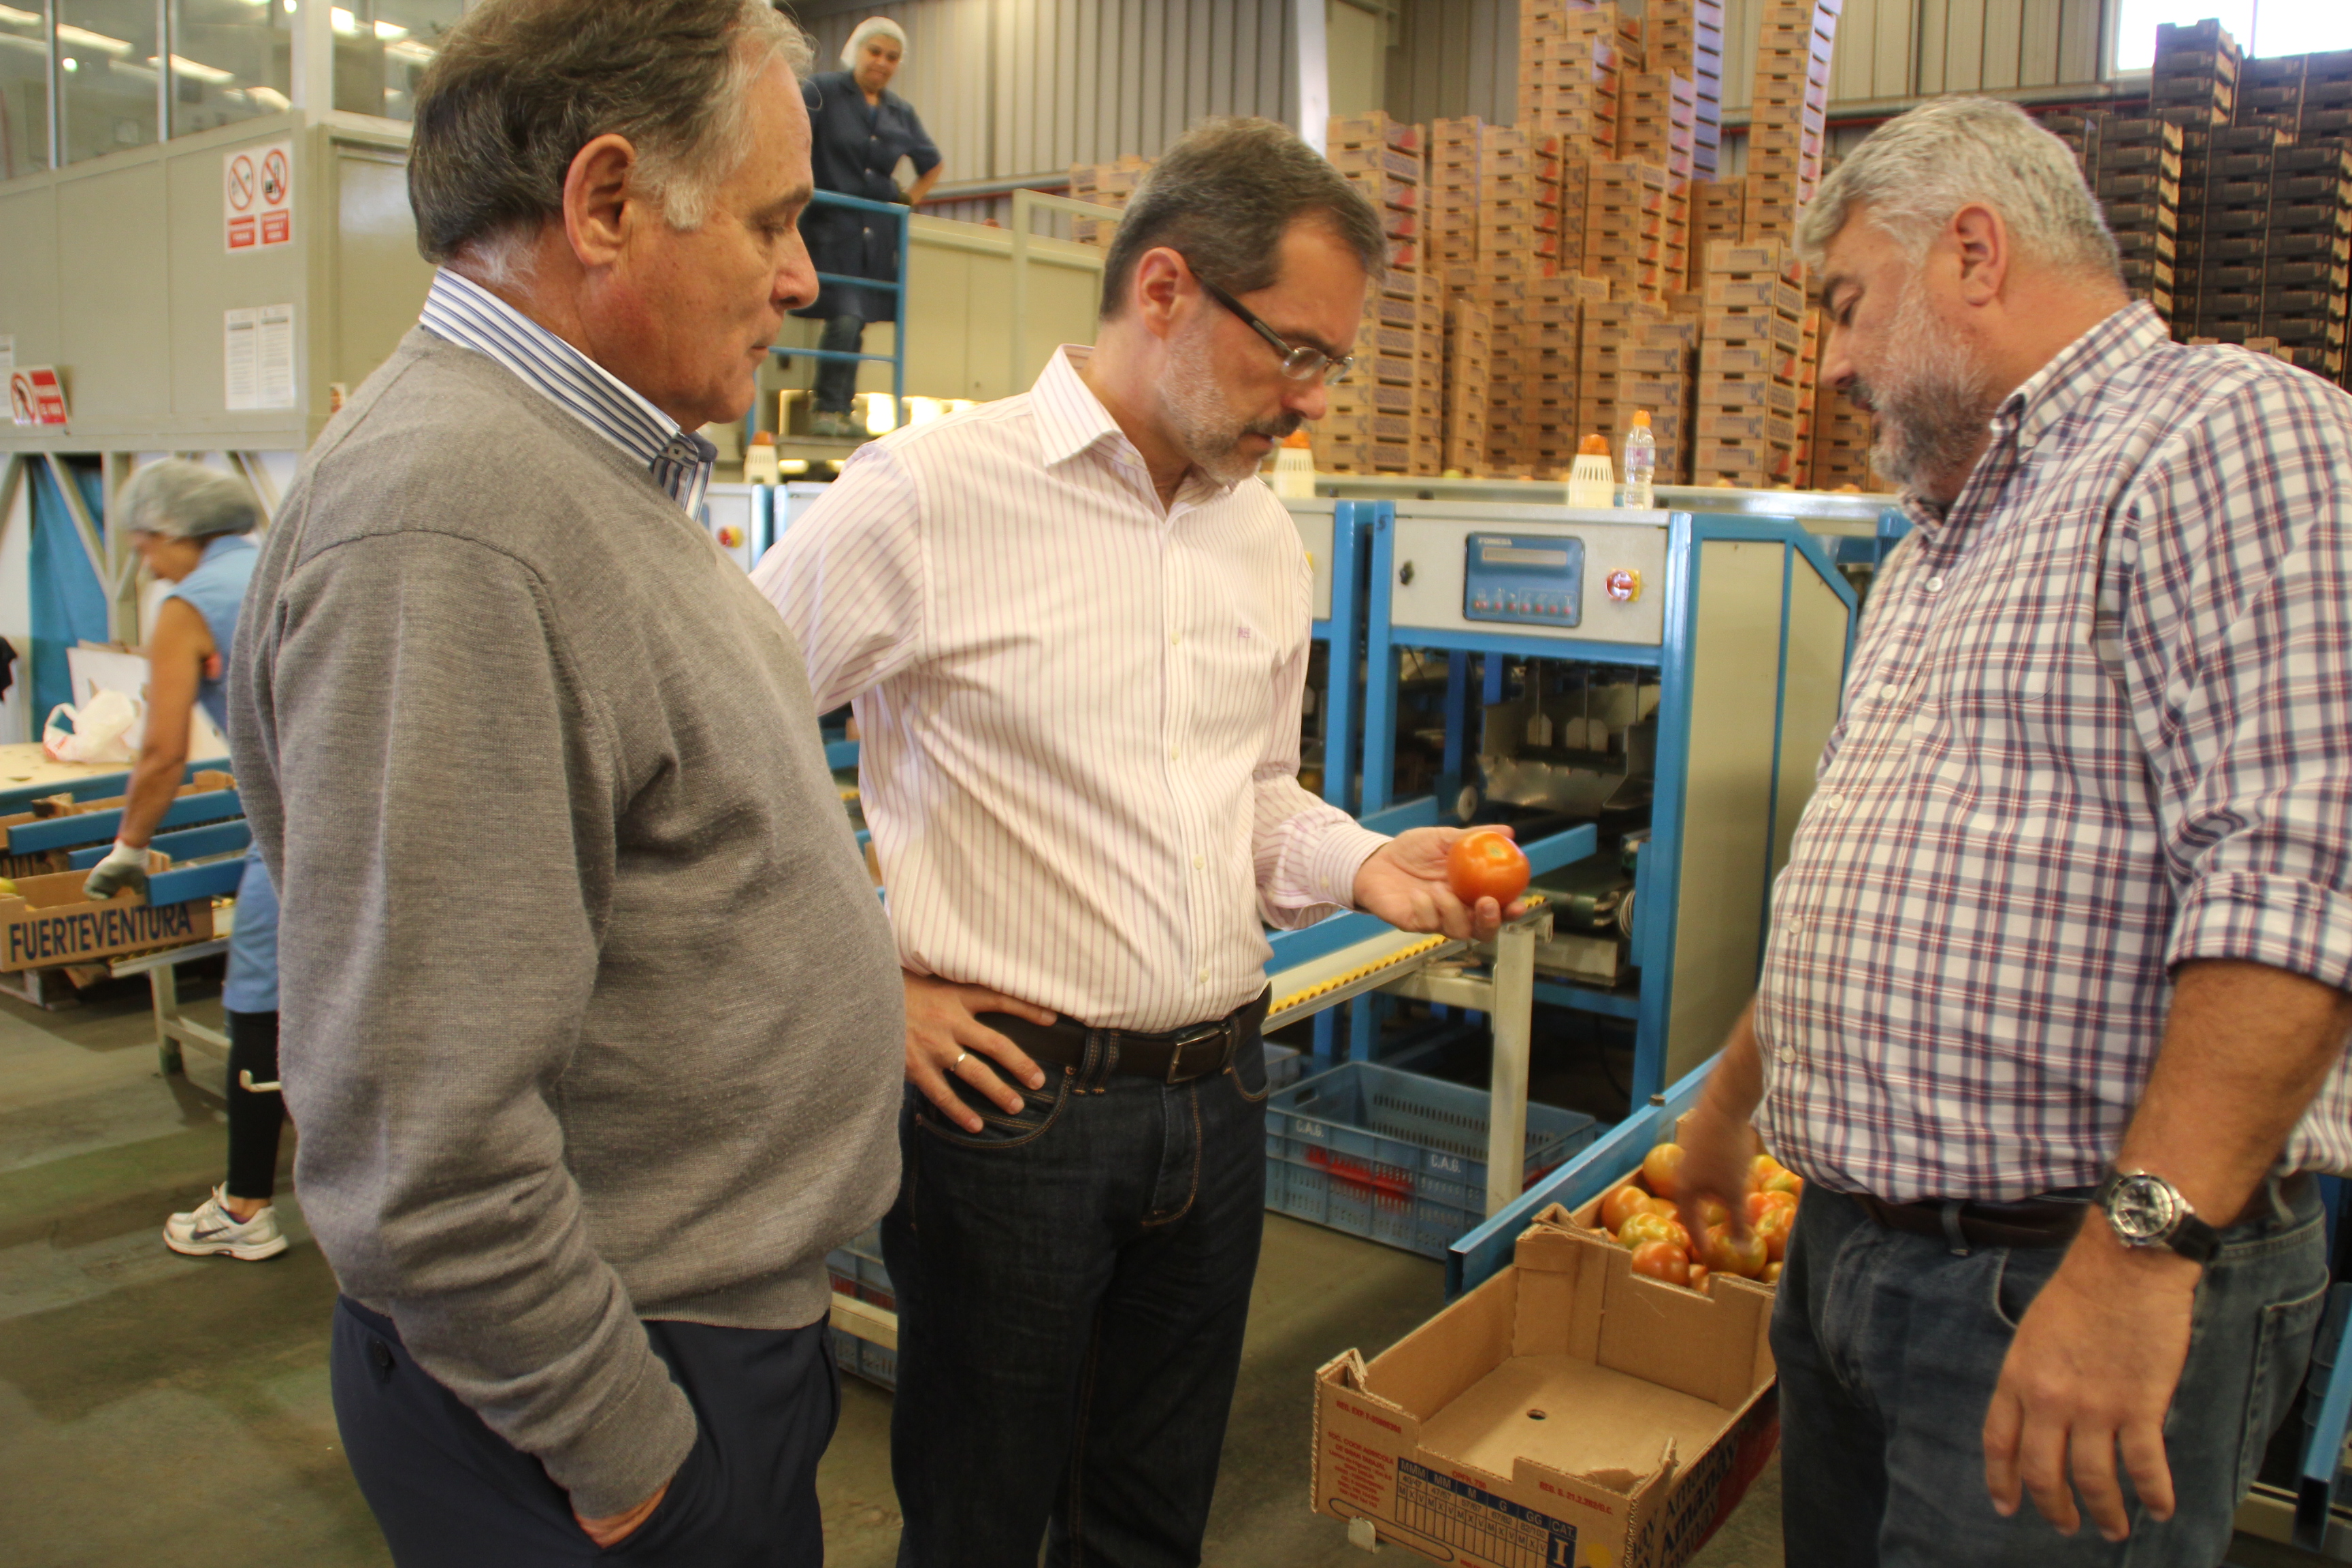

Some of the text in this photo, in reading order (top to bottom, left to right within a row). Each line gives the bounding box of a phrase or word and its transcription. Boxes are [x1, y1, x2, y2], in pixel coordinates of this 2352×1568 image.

[9, 902, 193, 963] FUERTEVENTURA
[1399, 1486, 1546, 1552] M X V M X V M X V M X V M X V
[1401, 1460, 1426, 1478] MMM
[1434, 1475, 1451, 1489] MM
[1468, 1488, 1477, 1499] M
[1499, 1501, 1507, 1512] G
[1526, 1512, 1543, 1524] GG
[1552, 1521, 1574, 1538] CAT.
